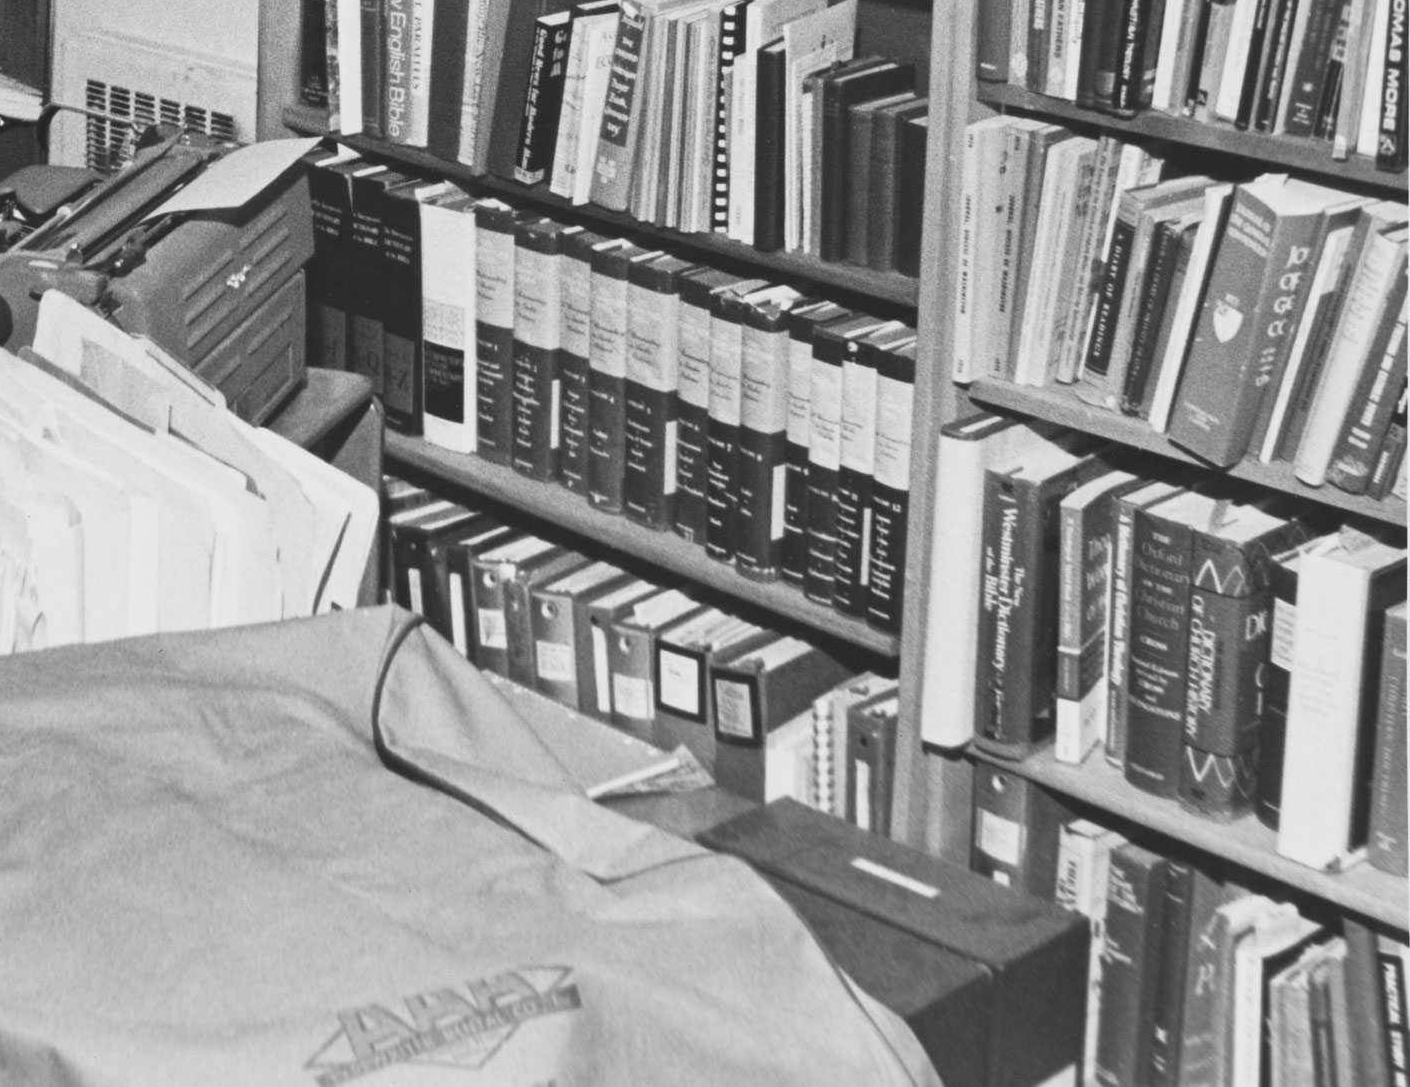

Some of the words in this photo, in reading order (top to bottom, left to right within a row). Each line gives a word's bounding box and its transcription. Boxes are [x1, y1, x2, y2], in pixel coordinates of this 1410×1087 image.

[387, 11, 405, 84] English
[535, 27, 548, 58] Good
[1053, 13, 1066, 60] FATHERS
[533, 59, 545, 86] News
[1120, 41, 1137, 81] THEOLOGY
[388, 85, 405, 138] Bible
[531, 88, 541, 104] for
[1382, 67, 1403, 131] MORE
[526, 104, 539, 146] Modern
[521, 148, 533, 171] Man
[1108, 245, 1123, 278] DIARY
[1104, 282, 1116, 298] OF
[1091, 303, 1113, 360] READINGS
[984, 556, 995, 573] the
[998, 507, 1018, 594] Westminster
[1115, 523, 1130, 576] Dictionary
[983, 574, 999, 612] Bible
[1013, 566, 1025, 583] The
[1115, 578, 1127, 589] of
[1012, 585, 1024, 608] New
[1113, 590, 1128, 638] Christian
[1191, 595, 1206, 614] OF
[991, 595, 1012, 673] Dictionary
[1139, 610, 1180, 630] Church
[1110, 639, 1127, 686] Theology
[1189, 617, 1204, 674] CHURCH
[1199, 629, 1216, 714] DICTIONARY
[1186, 676, 1202, 739] HISTORY
[1382, 962, 1401, 1025] PRACTICAL
[1389, 1029, 1406, 1070] STUDY
